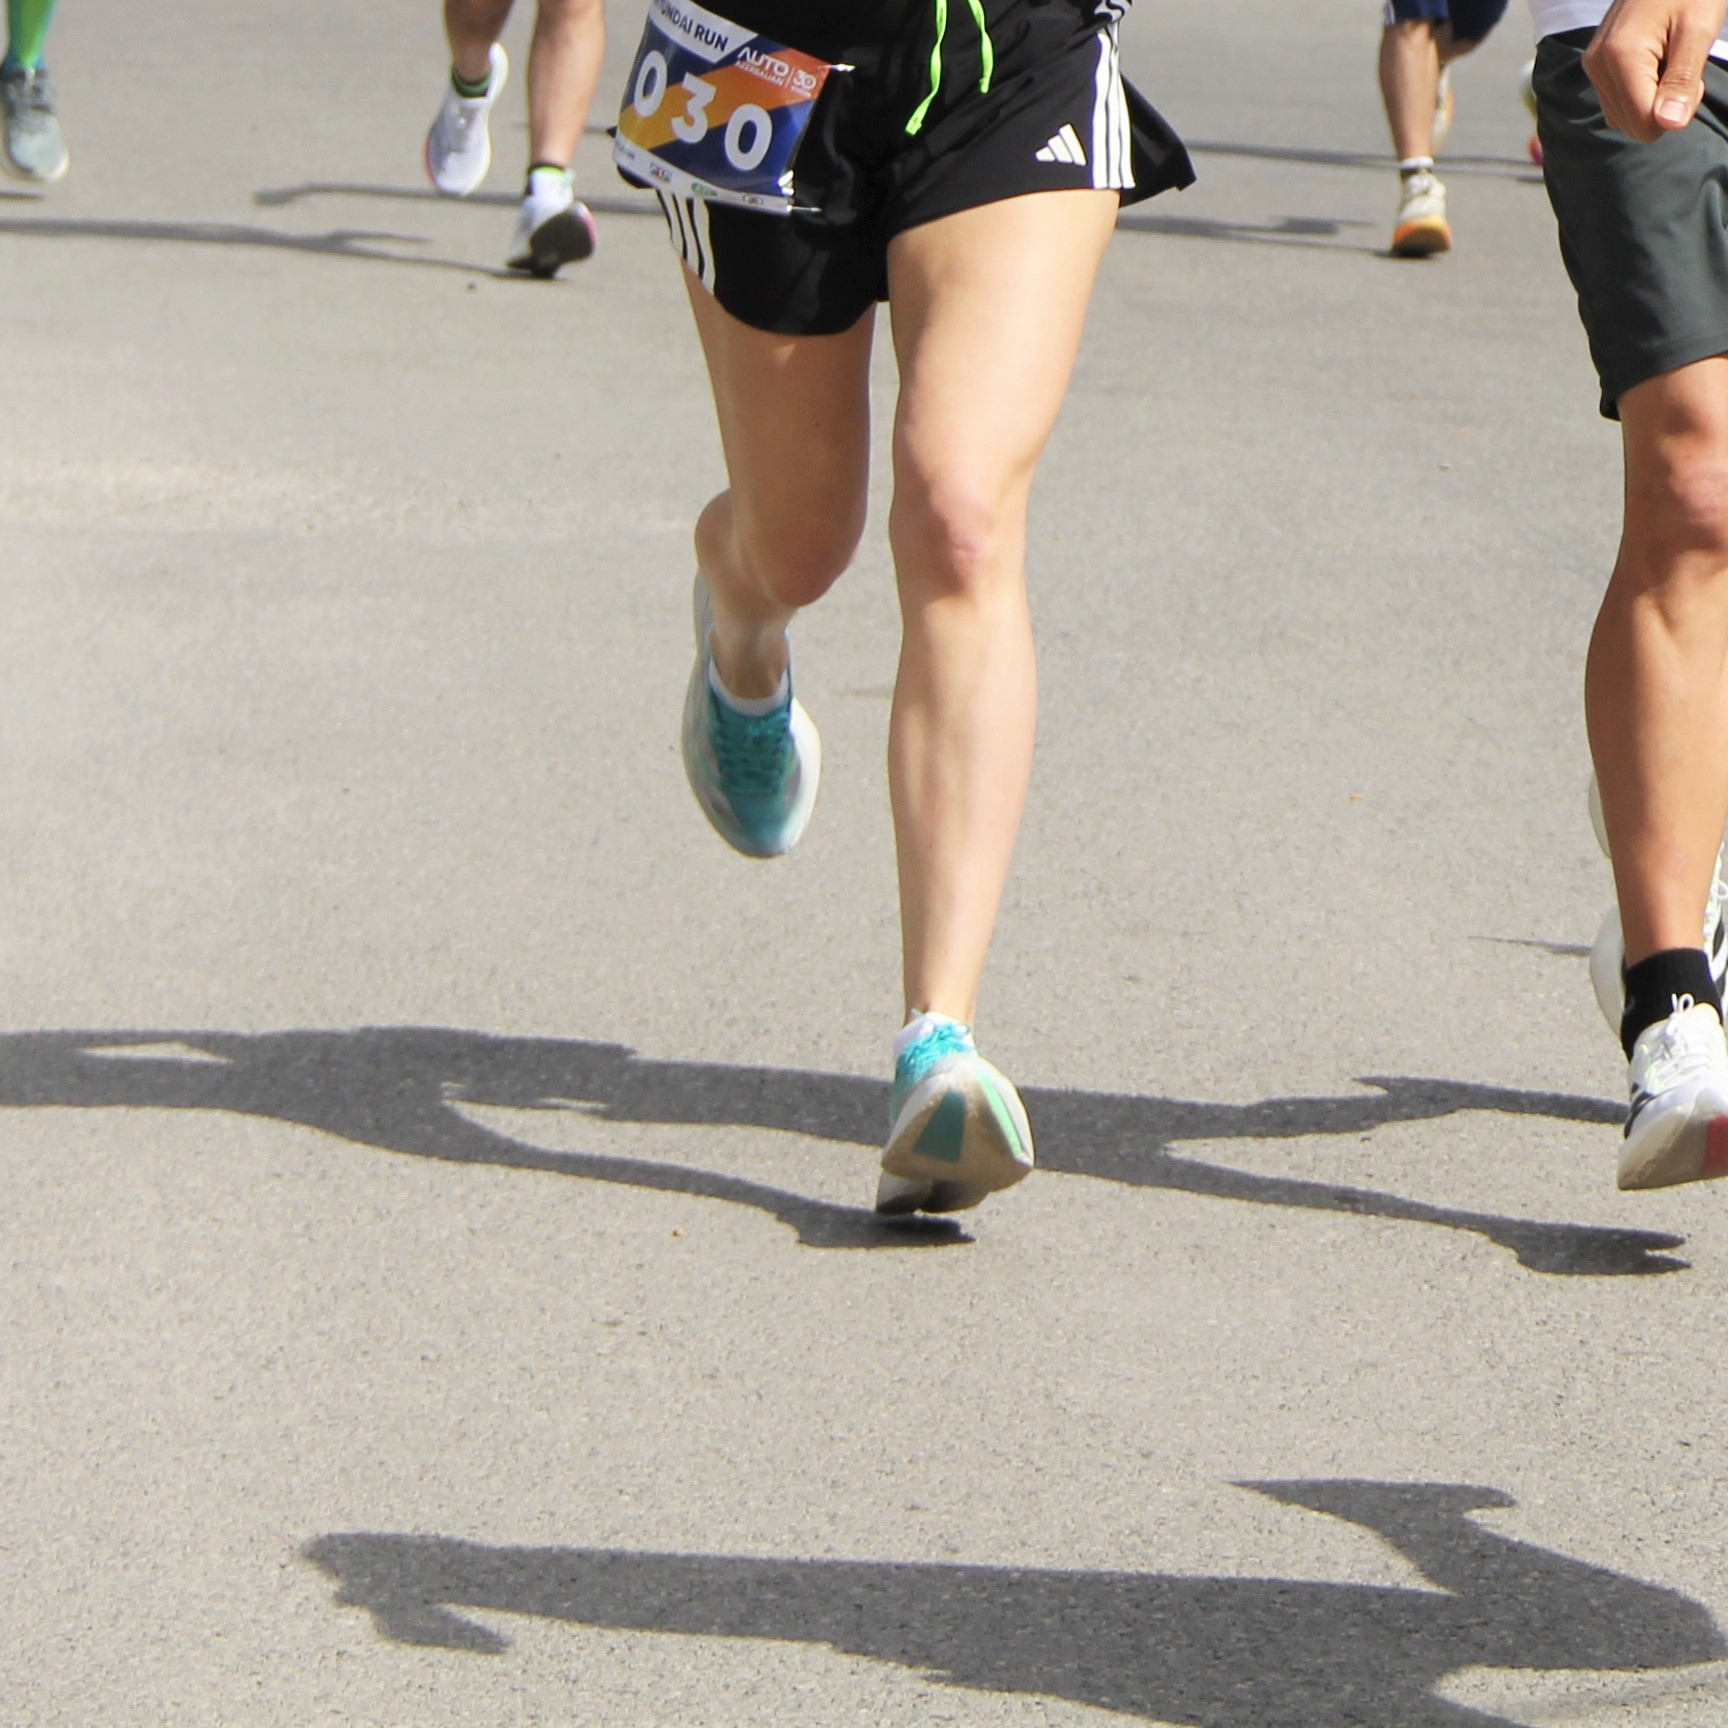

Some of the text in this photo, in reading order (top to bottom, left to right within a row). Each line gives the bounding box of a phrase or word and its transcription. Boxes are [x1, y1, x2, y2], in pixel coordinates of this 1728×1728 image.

[694, 22, 729, 53] RUN
[737, 46, 789, 77] AUTO
[633, 50, 772, 171] 030
